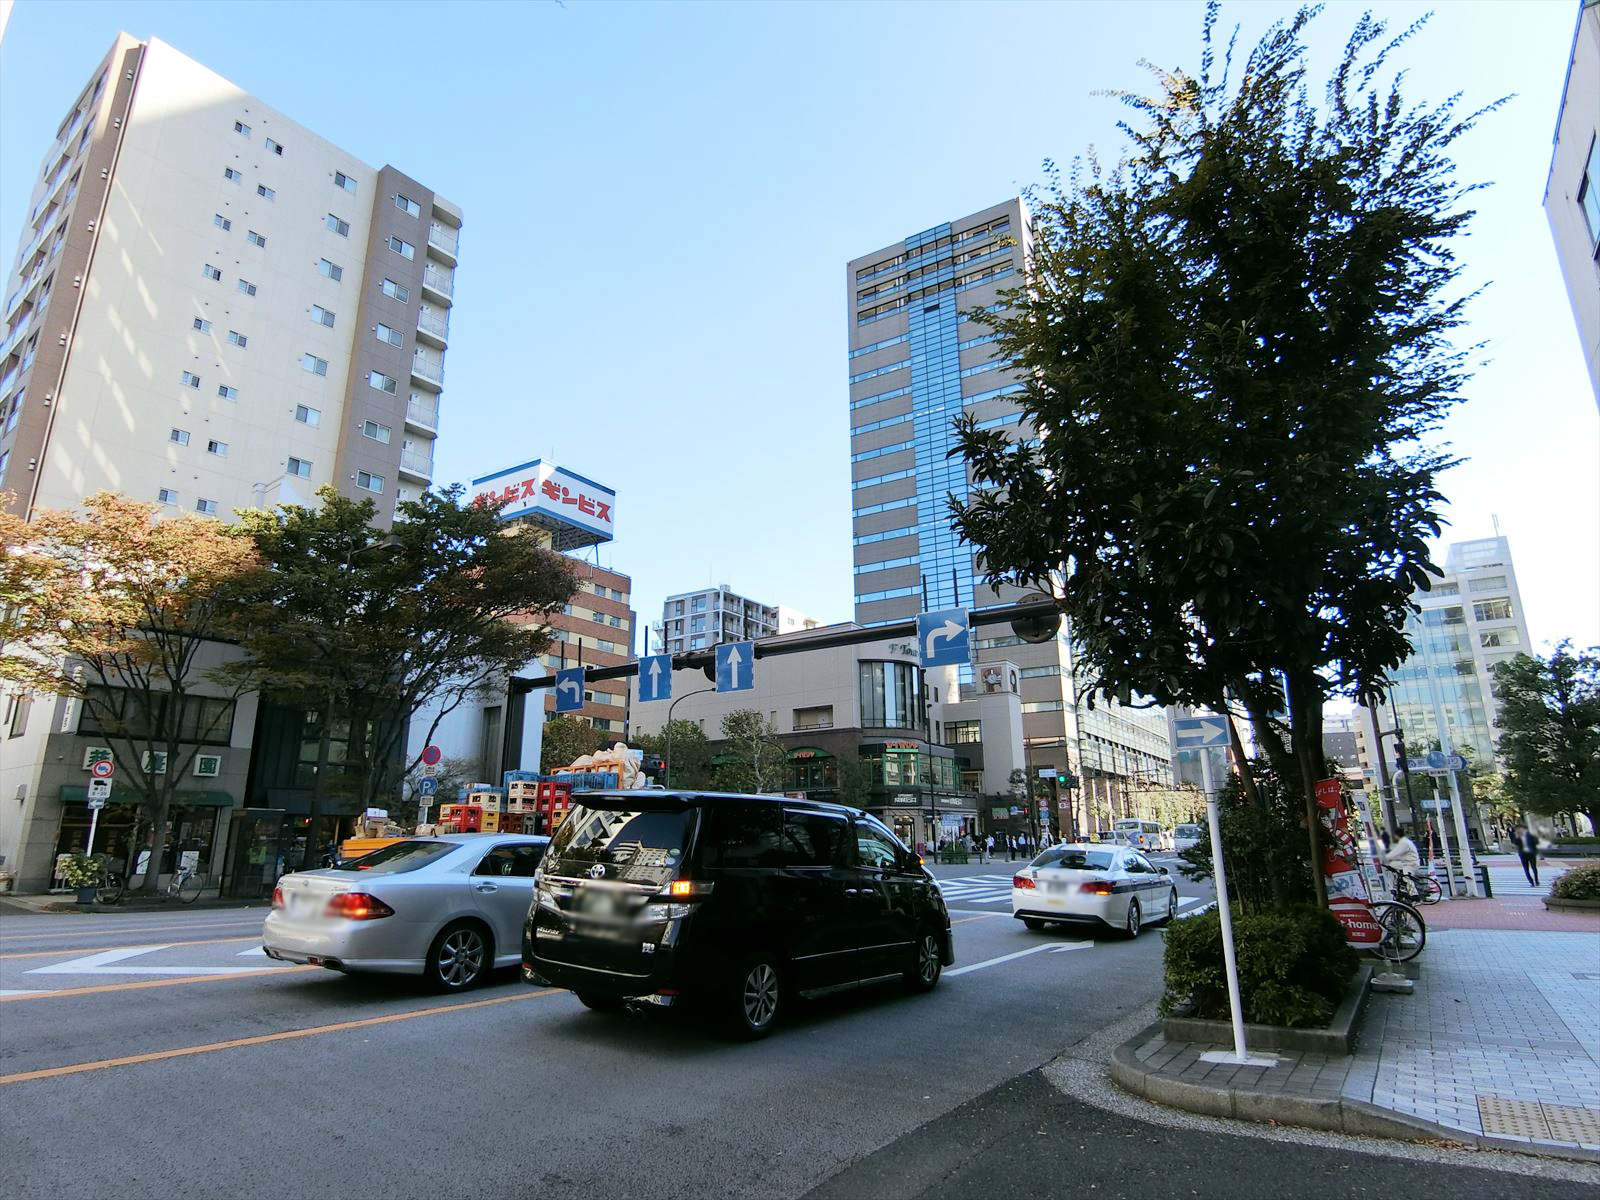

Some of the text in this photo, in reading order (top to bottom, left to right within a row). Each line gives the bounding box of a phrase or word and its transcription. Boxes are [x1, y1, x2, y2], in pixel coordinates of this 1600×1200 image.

[541, 479, 611, 523] ギンビス
[1347, 918, 1380, 930] home
